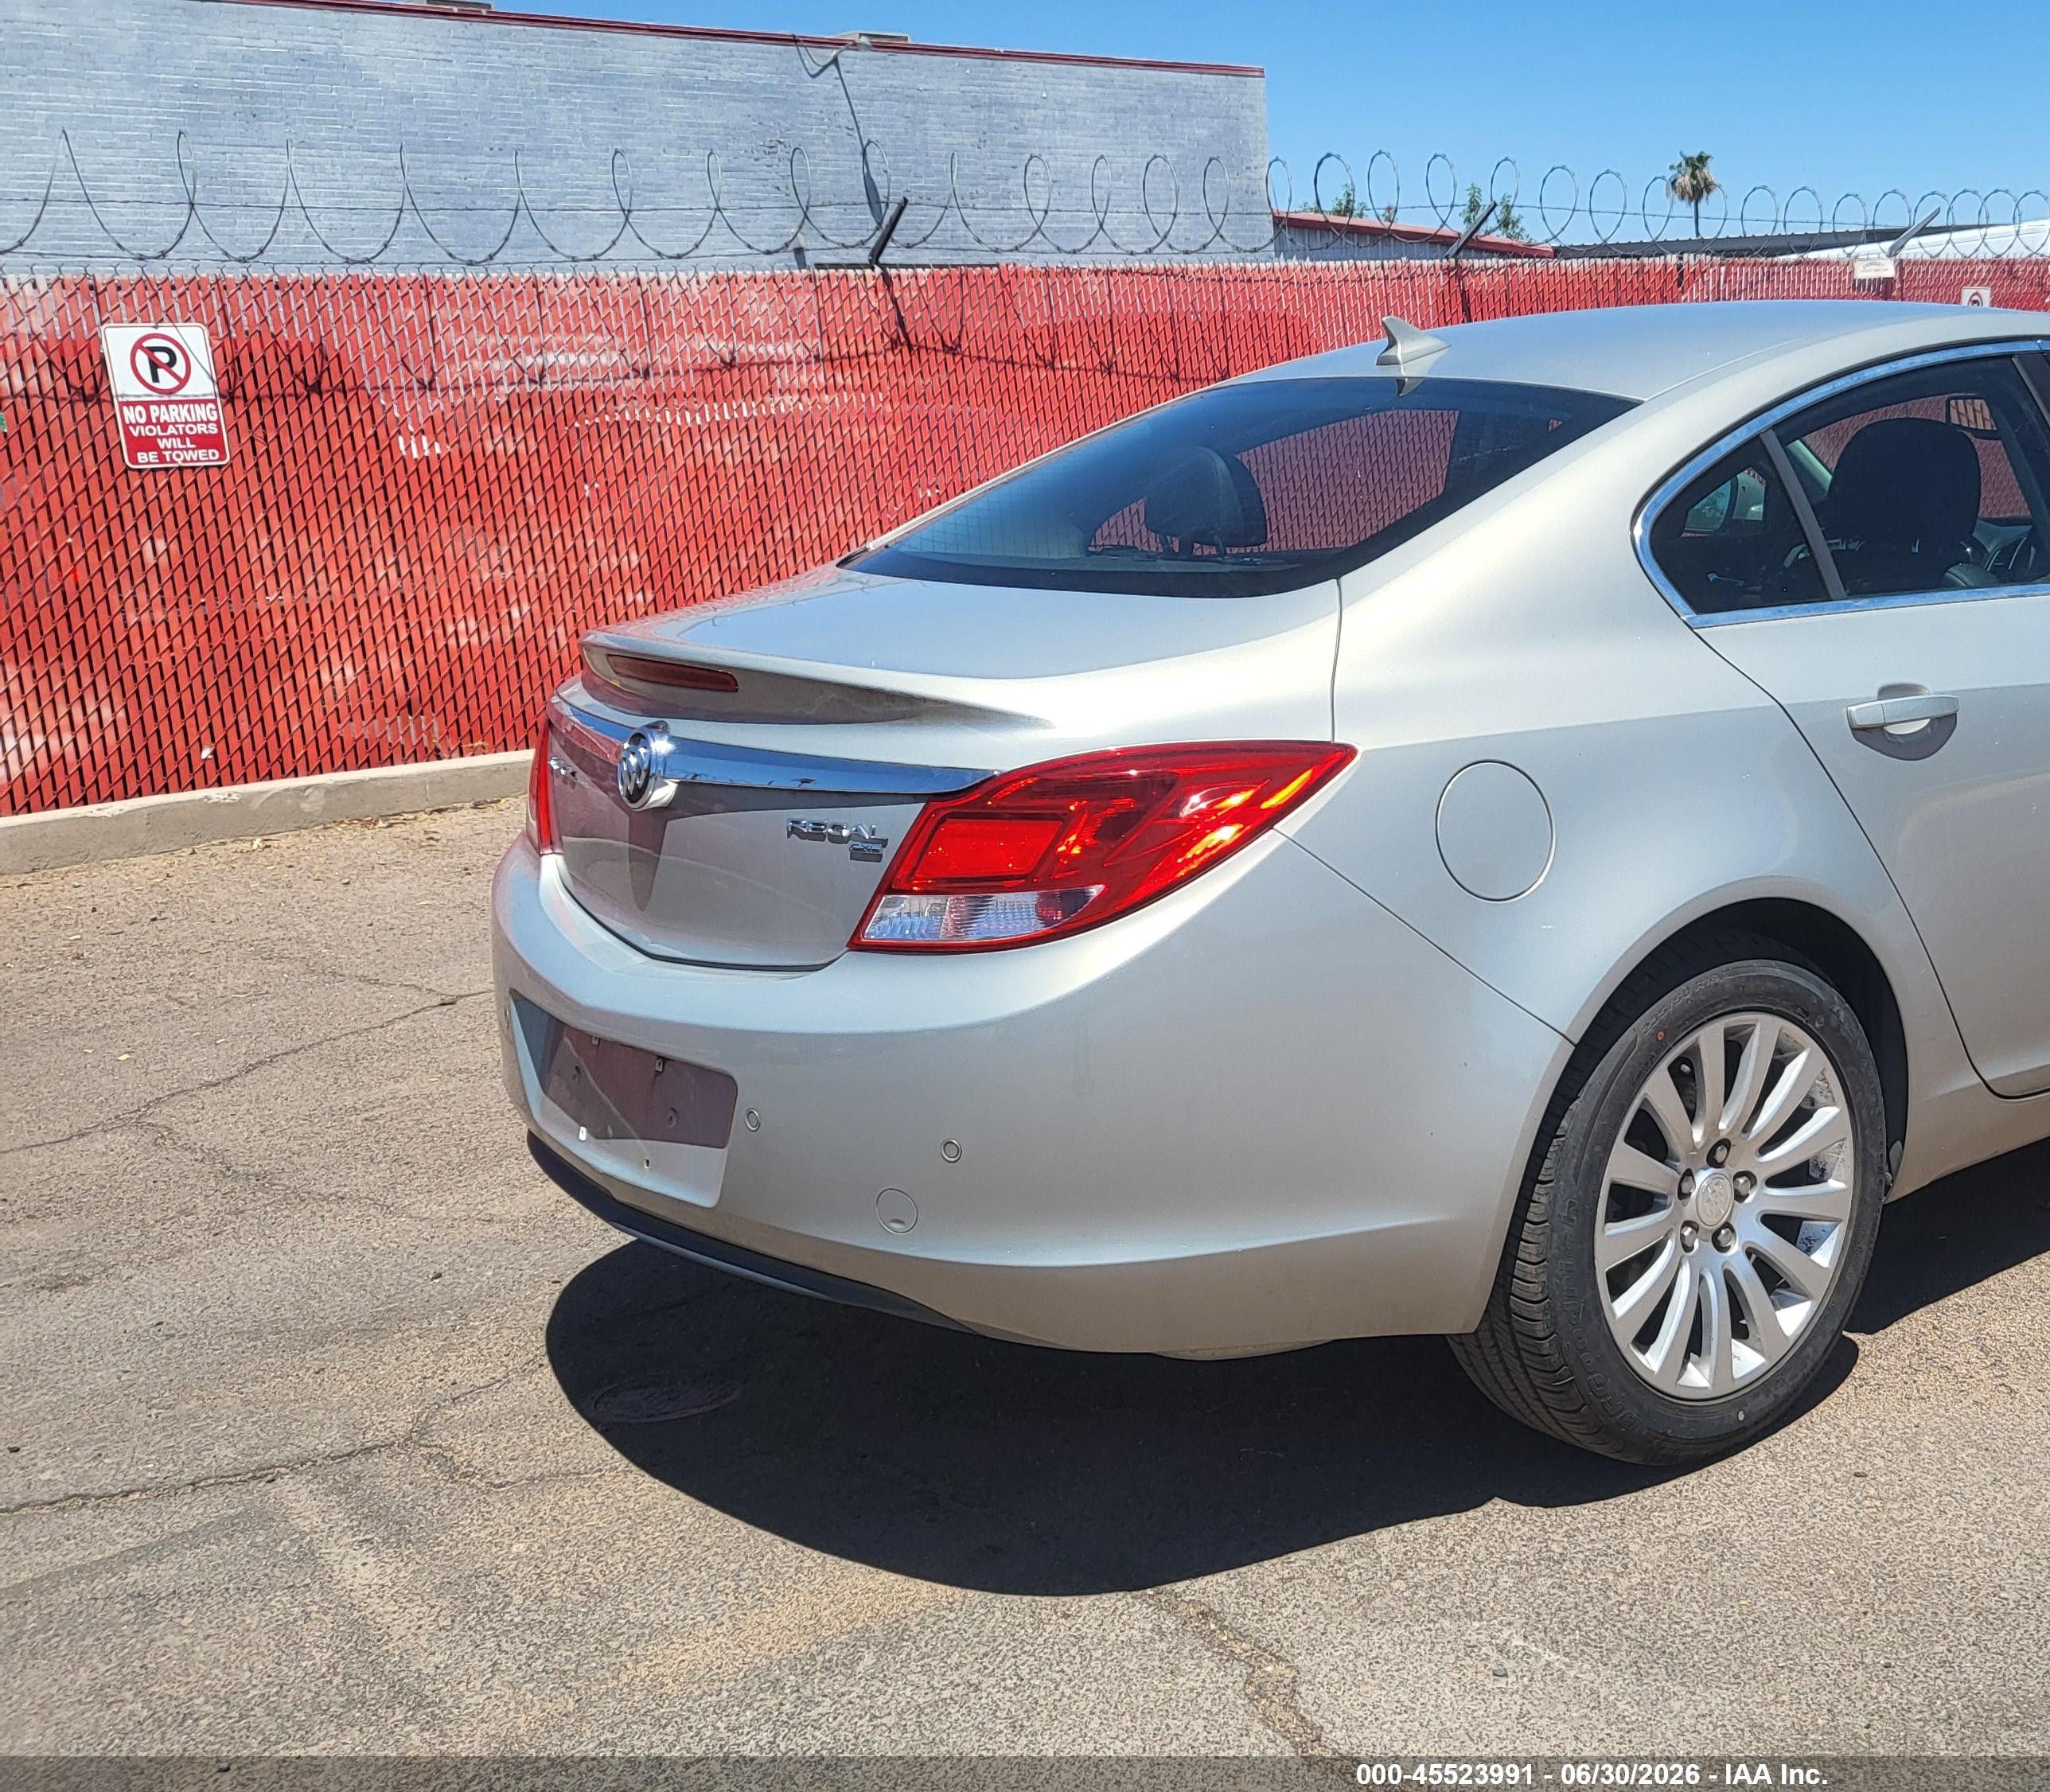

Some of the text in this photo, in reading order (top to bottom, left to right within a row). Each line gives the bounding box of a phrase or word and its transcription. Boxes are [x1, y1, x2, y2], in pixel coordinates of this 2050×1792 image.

[123, 403, 218, 424] NO PARKING
[128, 423, 218, 437] VIOLATORS
[157, 438, 196, 450] WILL
[137, 450, 219, 463] BE TOWED
[786, 818, 888, 843] REGAL
